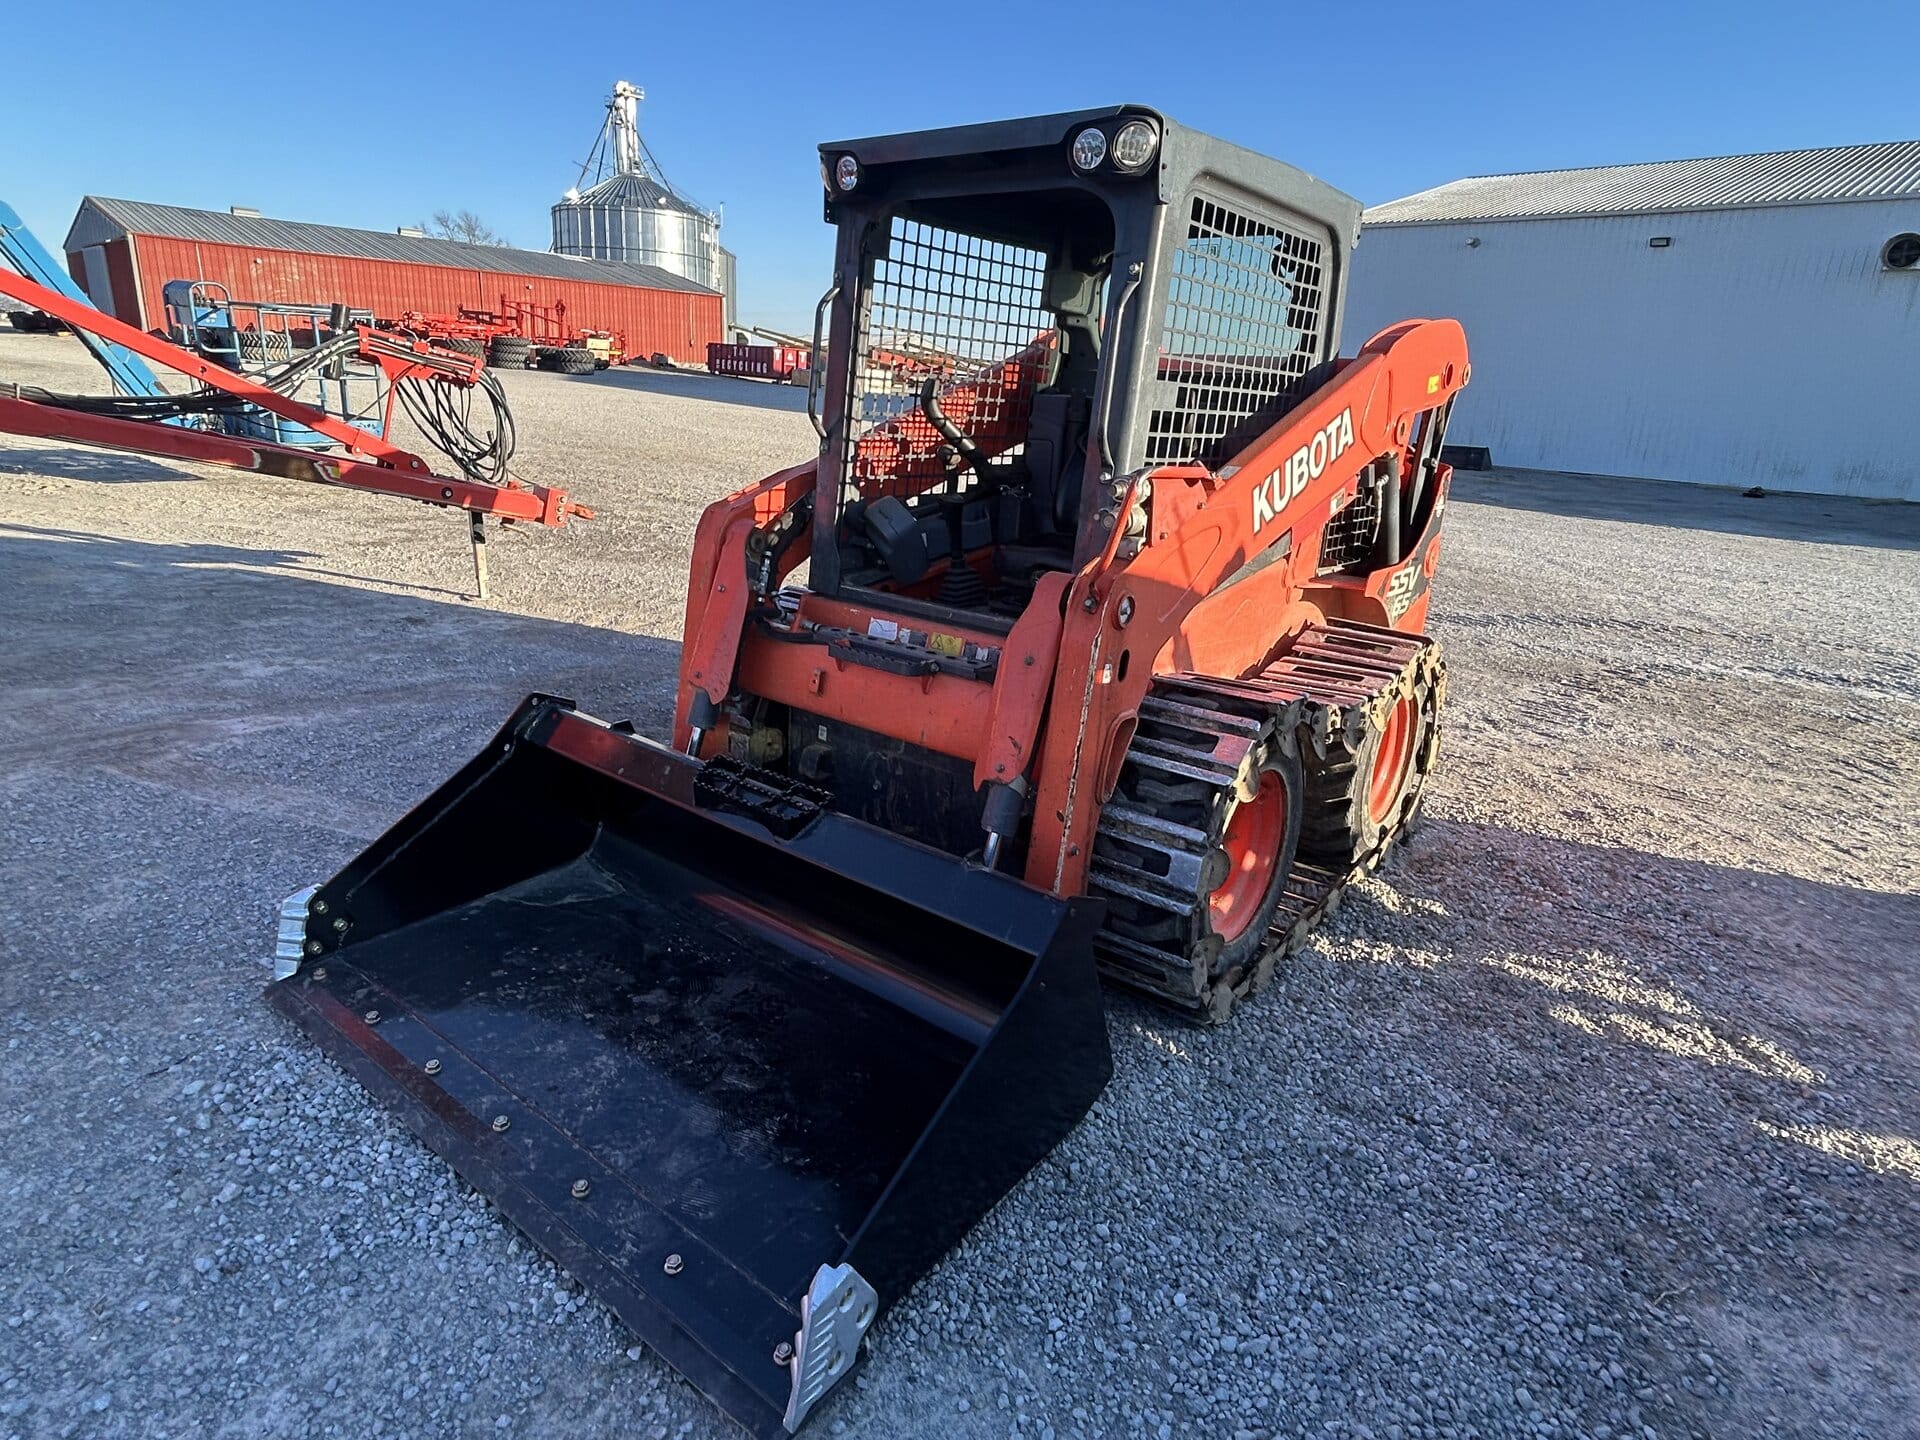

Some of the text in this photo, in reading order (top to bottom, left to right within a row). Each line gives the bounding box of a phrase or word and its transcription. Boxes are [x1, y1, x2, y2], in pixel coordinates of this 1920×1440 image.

[715, 358, 768, 374] RECYCLING
[1252, 406, 1355, 536] KUBOTA
[1387, 563, 1422, 597] SSV
